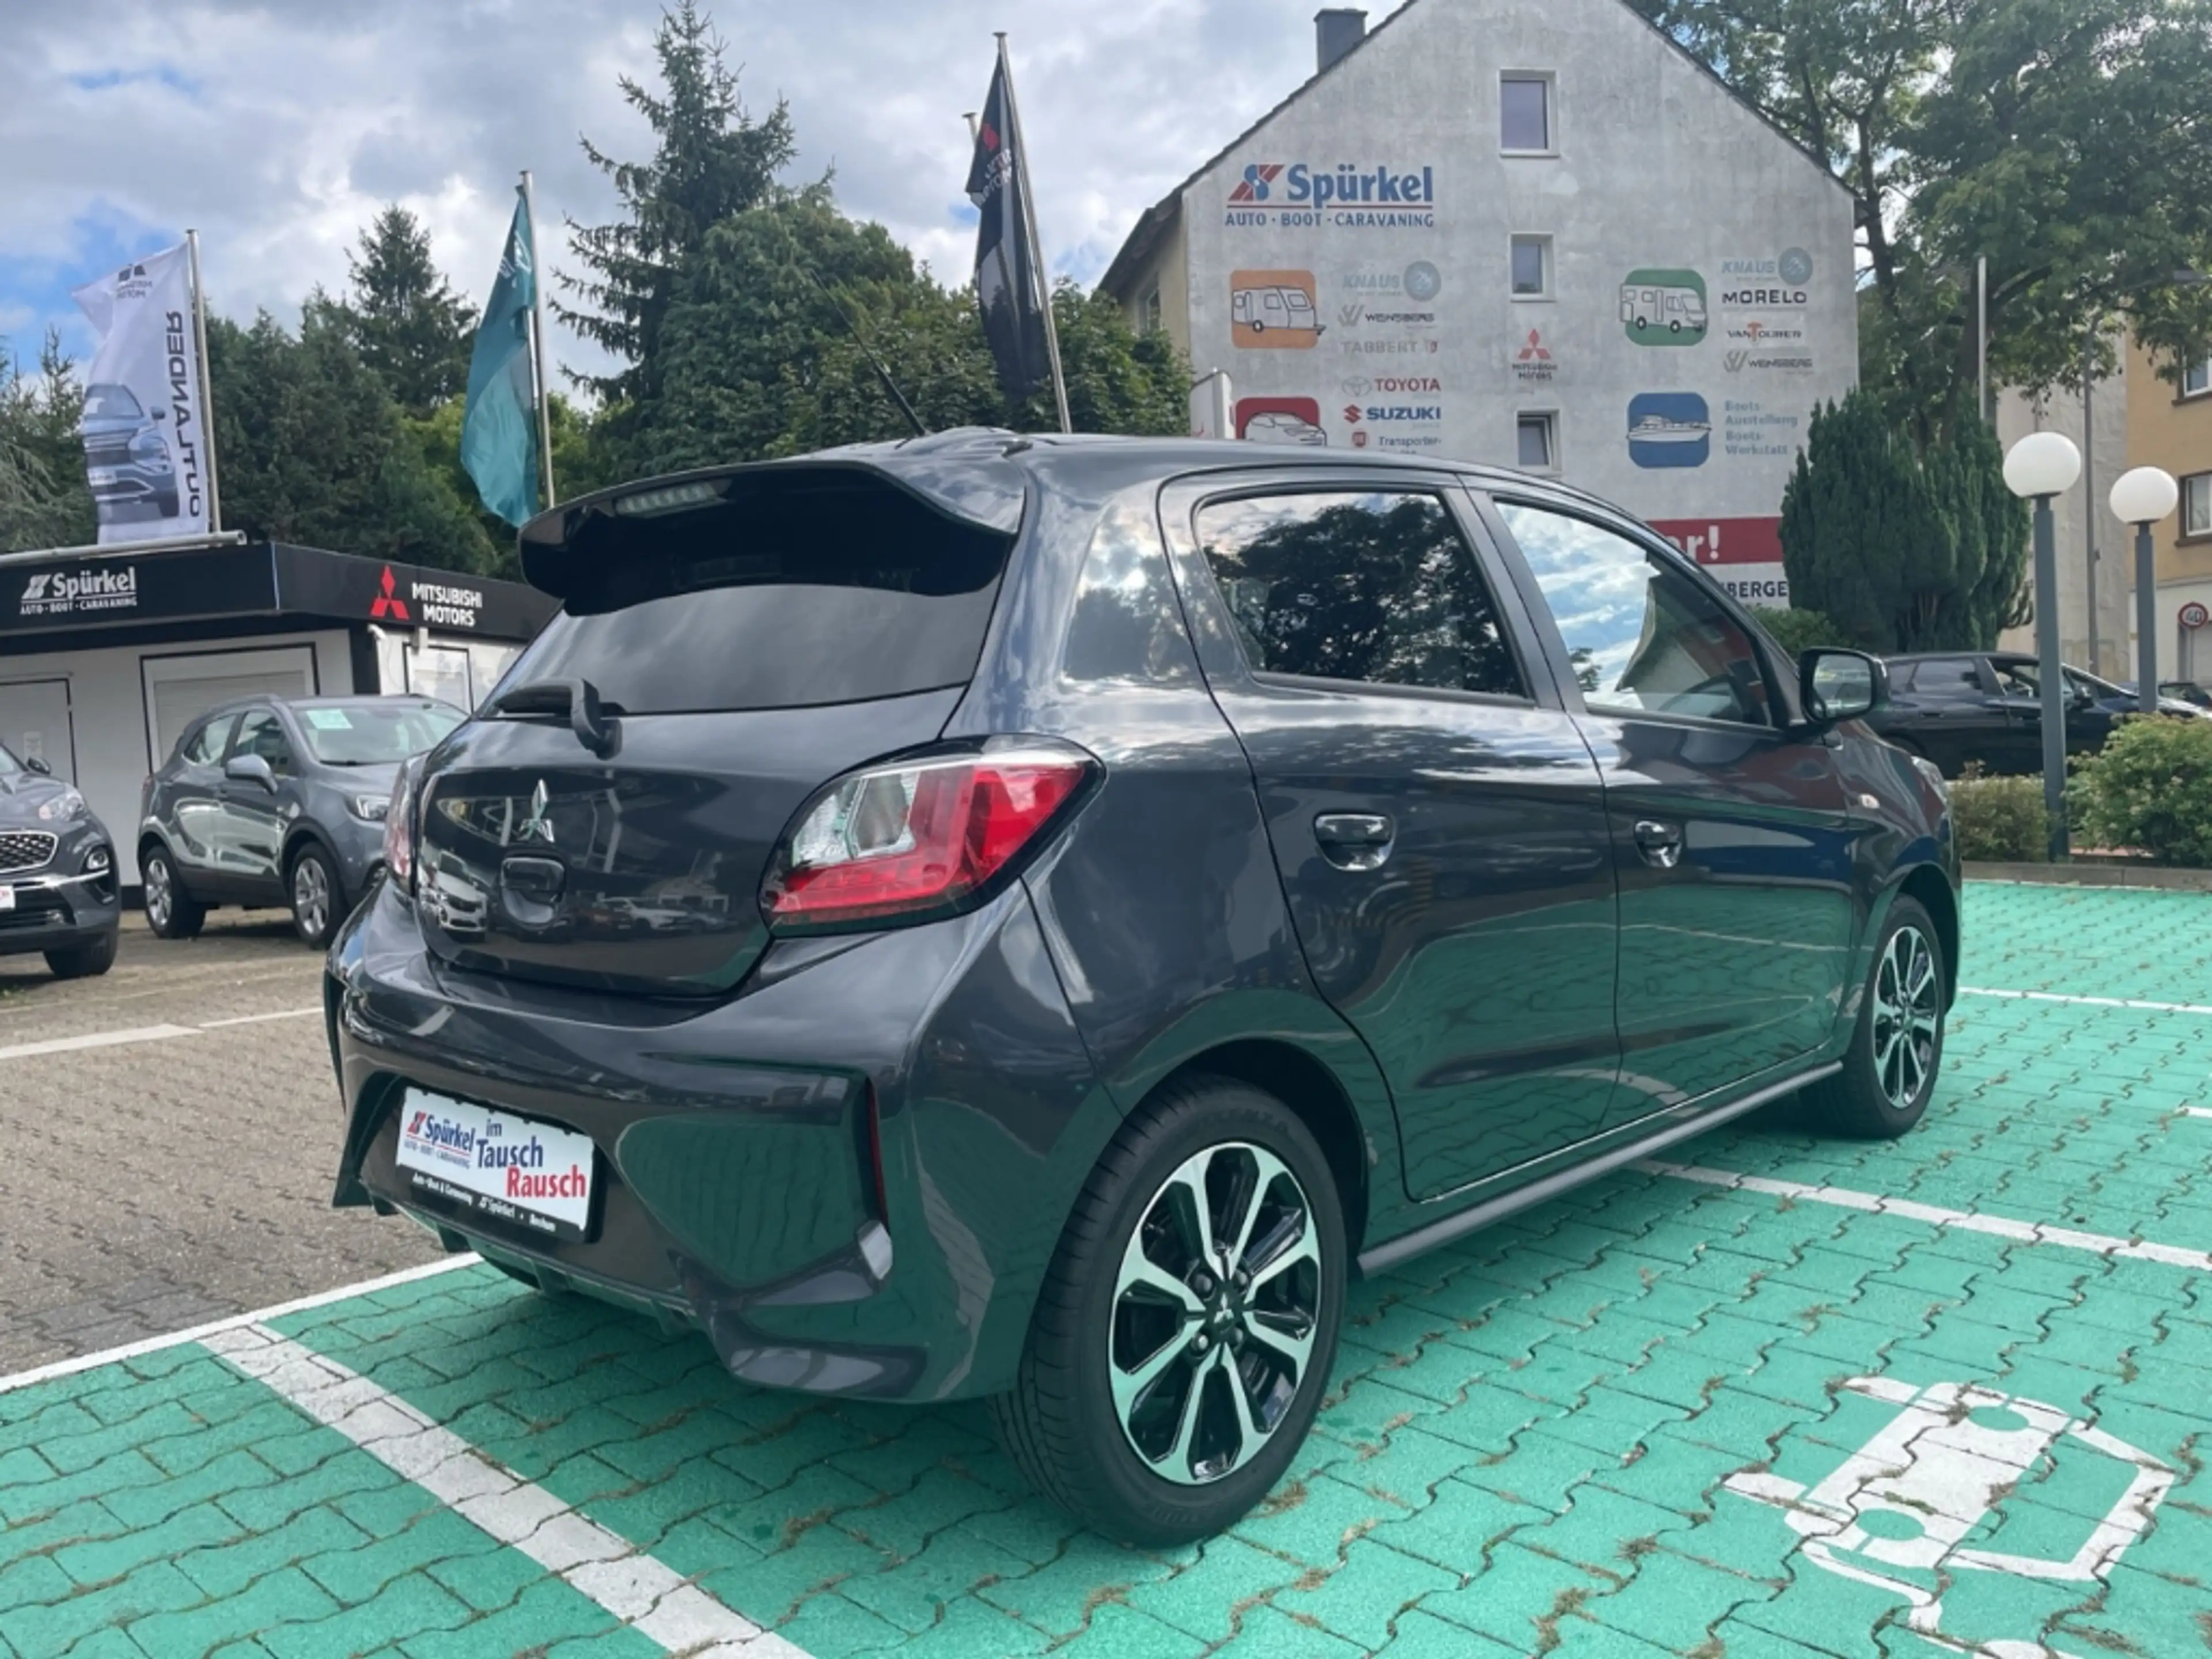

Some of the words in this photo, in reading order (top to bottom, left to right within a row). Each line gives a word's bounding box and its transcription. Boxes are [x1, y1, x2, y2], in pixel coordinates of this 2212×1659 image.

[1287, 164, 1433, 209] Spürkel
[1225, 212, 1267, 226] AUTO
[1281, 212, 1321, 226] BOOT
[1335, 212, 1434, 227] CARAVANING
[1722, 260, 1776, 274] KNAUS
[1343, 274, 1400, 289] KNAUS
[1722, 290, 1806, 304] MORELO
[1341, 341, 1418, 354] TABBERT
[1374, 378, 1441, 392] TOYOTA
[1366, 407, 1441, 420] SUZUKI
[52, 566, 136, 599] Spürkel
[412, 582, 483, 608] MITSUBISHI
[423, 604, 476, 627] MOTORS
[425, 1115, 476, 1153] Spürkel
[486, 1119, 502, 1137] im
[476, 1135, 543, 1168] Tausch
[506, 1165, 586, 1198] Rausch
